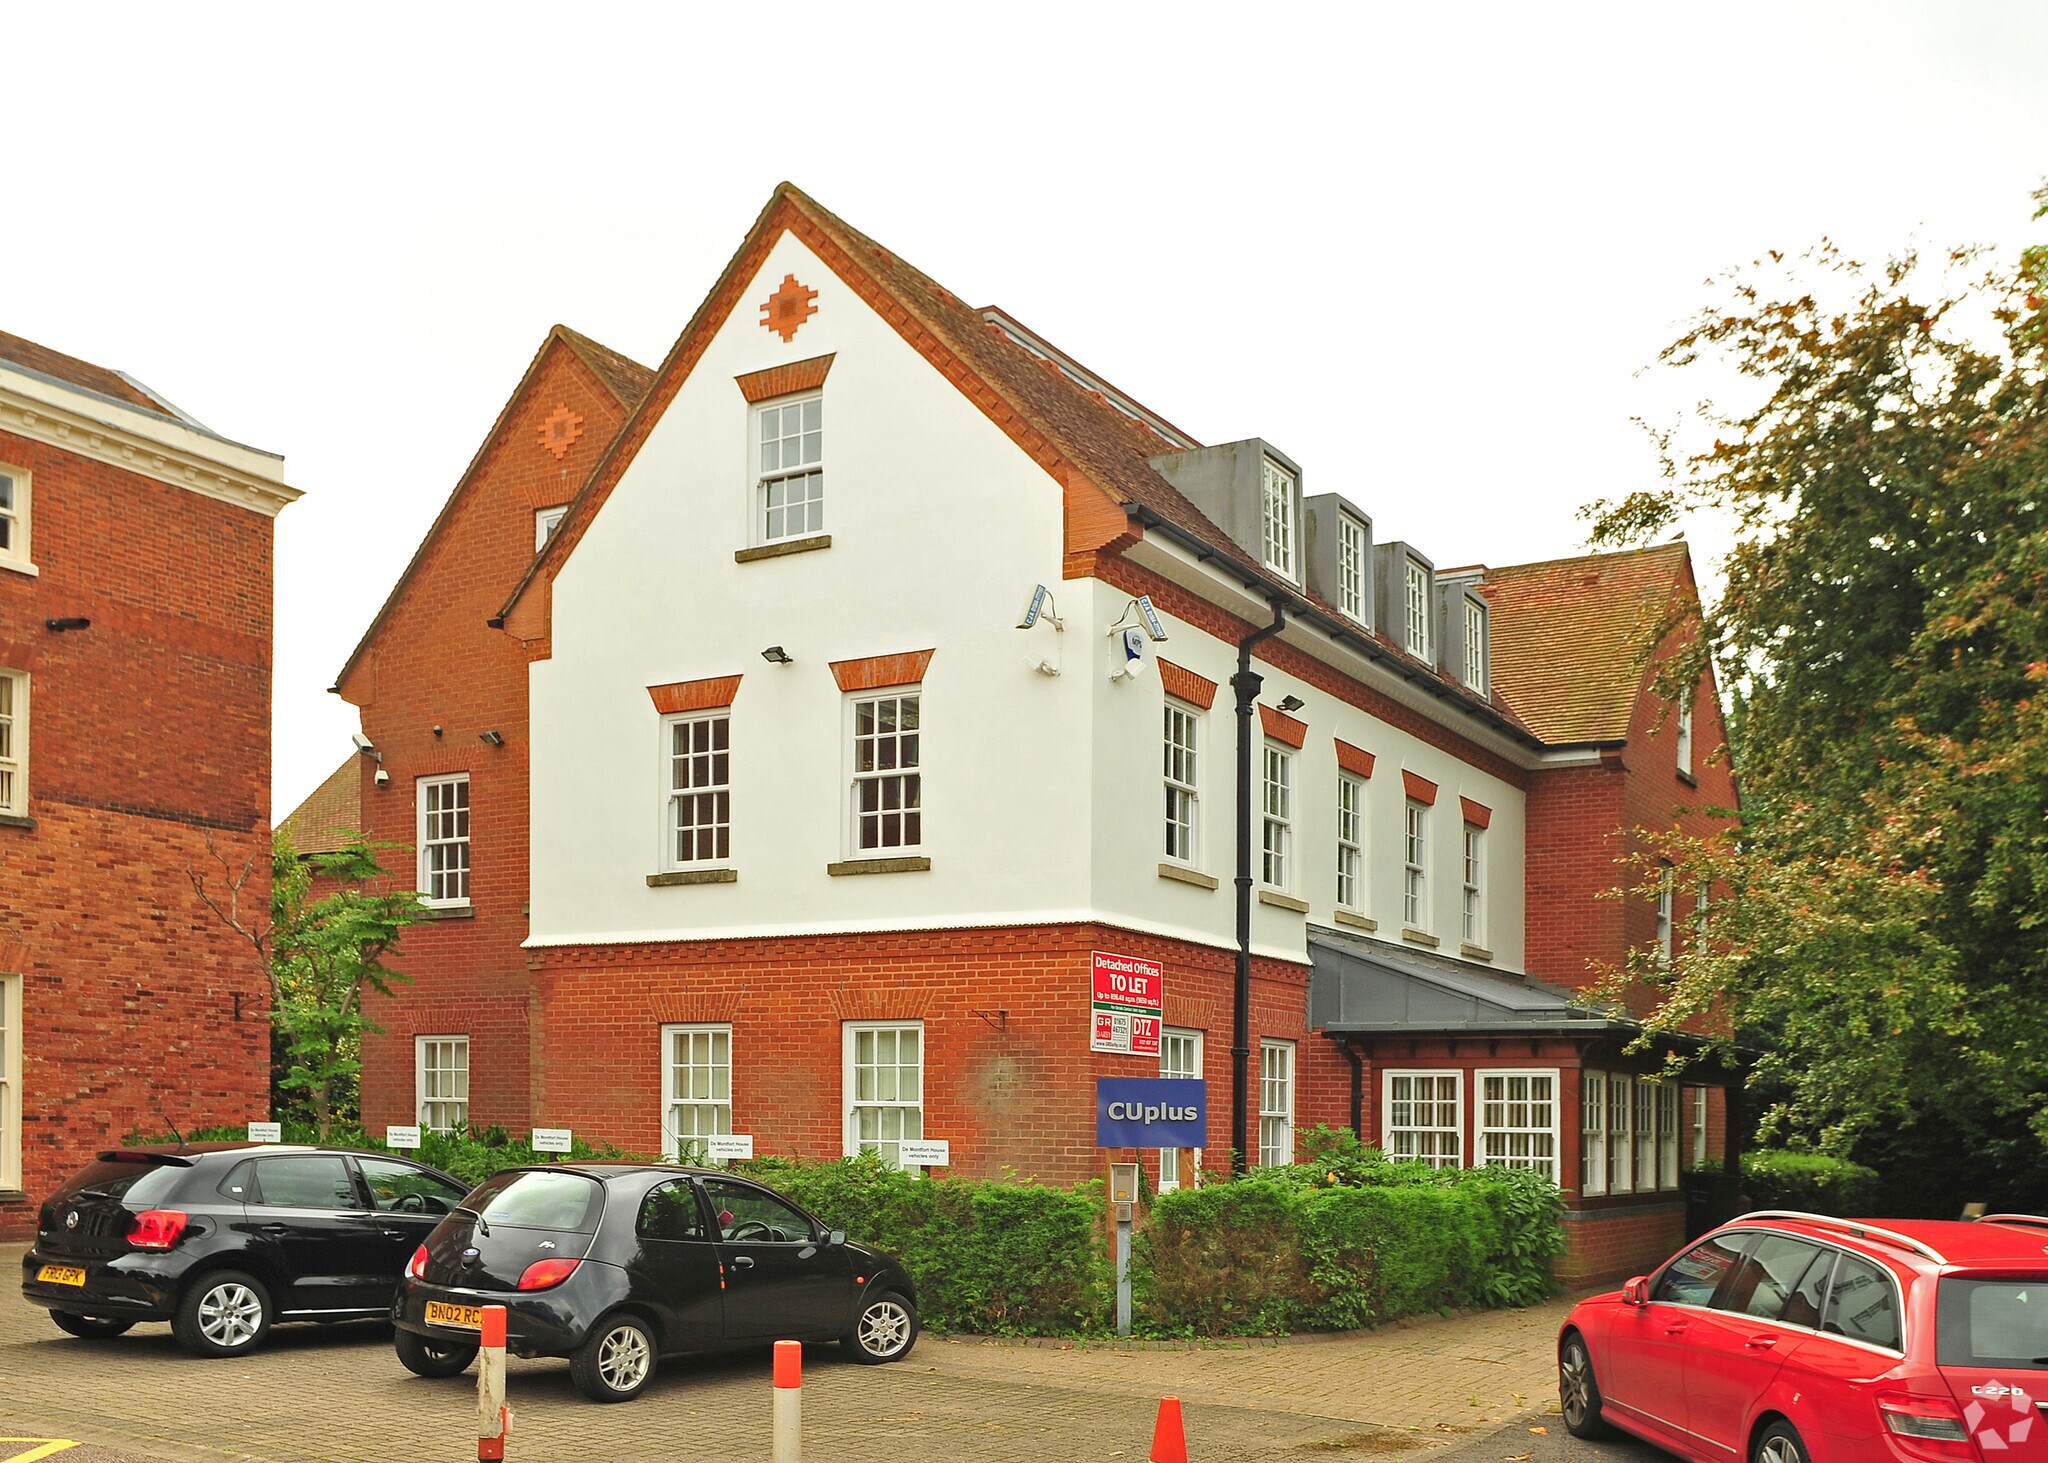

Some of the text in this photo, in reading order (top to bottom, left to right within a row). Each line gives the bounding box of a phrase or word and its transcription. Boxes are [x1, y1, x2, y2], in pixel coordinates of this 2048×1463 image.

[1096, 956, 1159, 976] Detached Offices
[1109, 974, 1148, 994] TO LET
[1096, 992, 1103, 1000] Up
[1098, 1017, 1111, 1026] GR
[1134, 1018, 1152, 1036] DTZ
[1107, 1102, 1198, 1124] CUplus
[431, 1305, 483, 1324] BN02 RC
